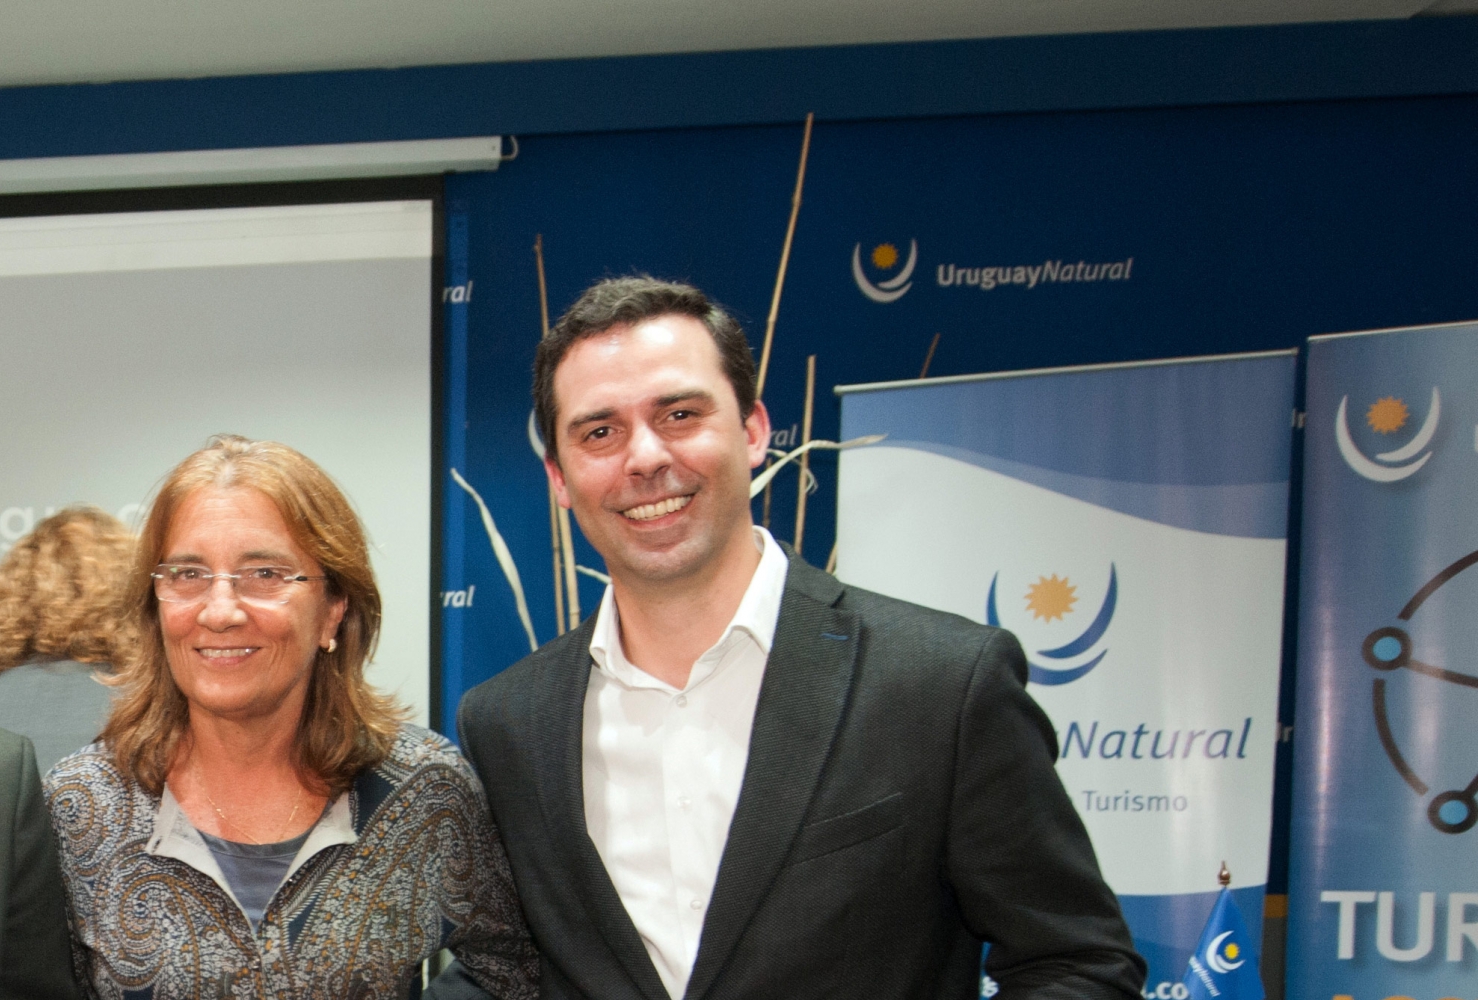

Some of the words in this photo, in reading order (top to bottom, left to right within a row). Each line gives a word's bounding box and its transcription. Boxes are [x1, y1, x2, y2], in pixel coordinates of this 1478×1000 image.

[936, 257, 1134, 290] UruguayNatural
[441, 585, 475, 608] ral
[1058, 716, 1253, 760] Natural
[1082, 789, 1189, 812] Turismo
[1320, 890, 1478, 962] TUR
